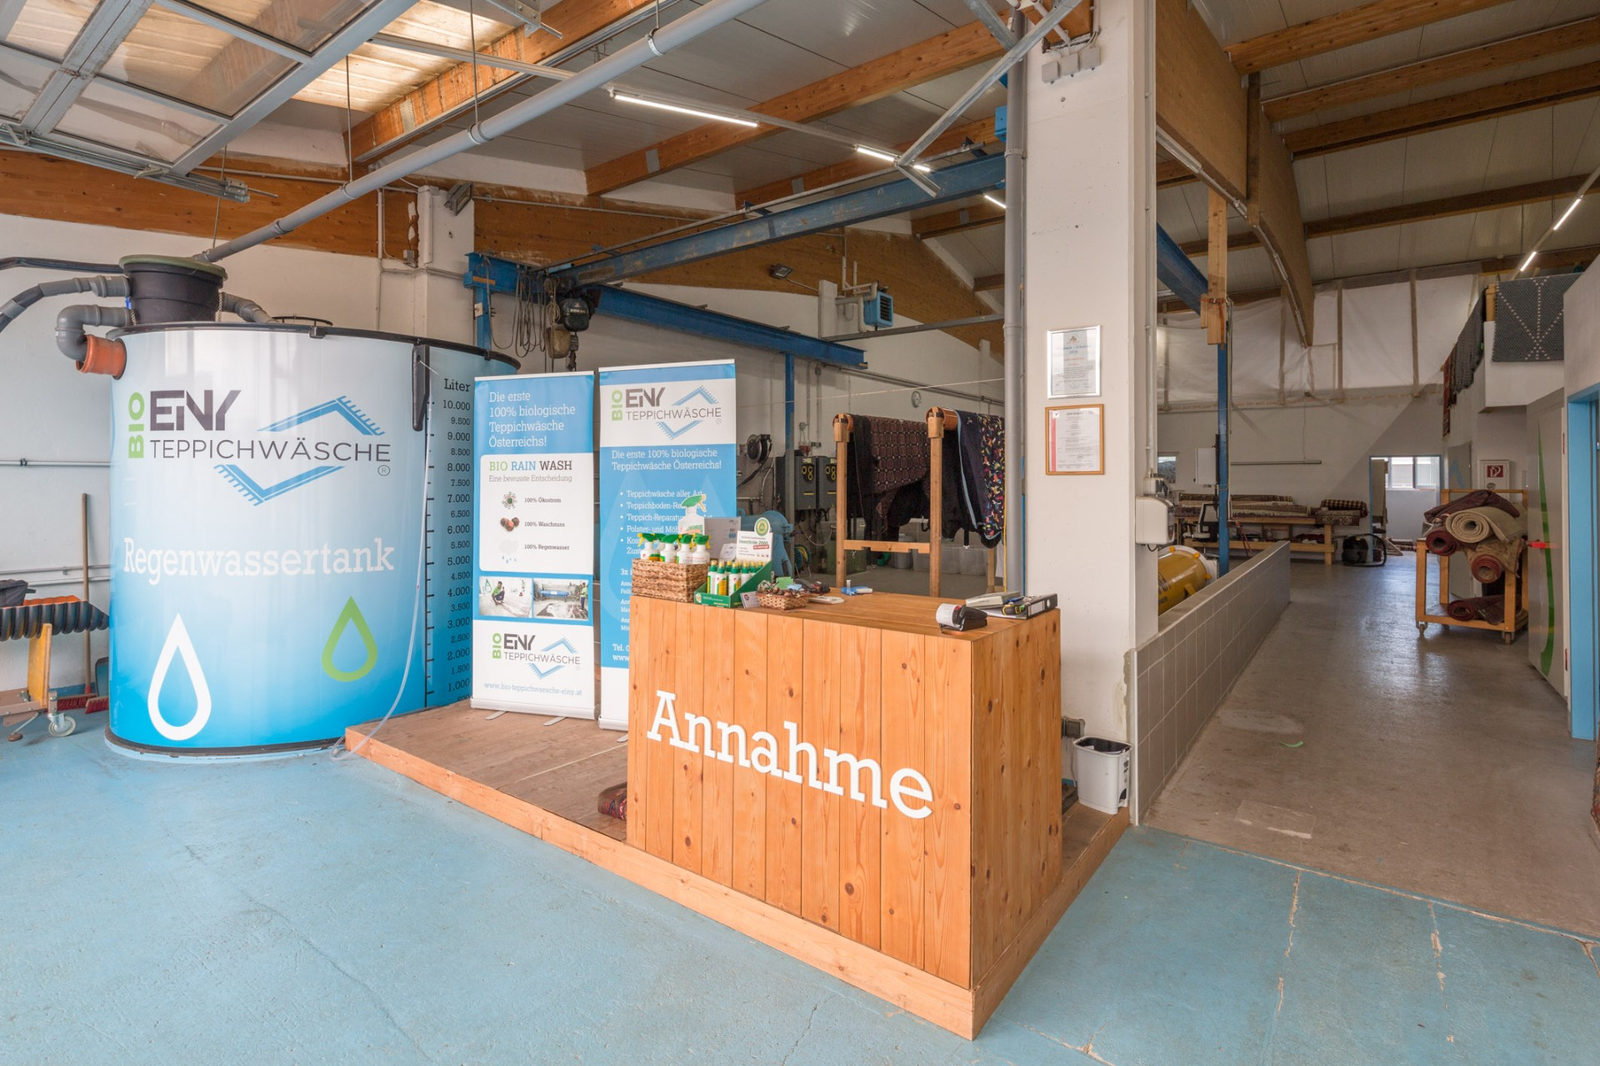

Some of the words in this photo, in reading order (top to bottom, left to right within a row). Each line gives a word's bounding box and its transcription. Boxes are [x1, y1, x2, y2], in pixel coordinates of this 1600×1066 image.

[444, 378, 471, 392] Liter
[489, 392, 505, 402] Die
[507, 392, 531, 402] erste
[443, 400, 470, 411] 10.000
[490, 406, 517, 418] 100%
[519, 404, 576, 418] biologische
[611, 389, 623, 421] BIO
[625, 407, 722, 421] TEPPICHWÄSCHE
[128, 392, 145, 459] BIO
[489, 420, 565, 434] Teppichwäsche
[448, 432, 470, 441] 9.000
[488, 436, 547, 448] Österreichs!
[150, 437, 391, 462] TEPPICHWÄSCHE
[611, 450, 624, 458] Die
[648, 450, 670, 458] 100%
[671, 448, 718, 460] biologische
[448, 463, 470, 472] 8.000
[489, 461, 508, 472] BIO
[511, 461, 536, 471] RAIN
[540, 460, 572, 470] WASH
[611, 461, 672, 472] Teppichwäsche
[673, 460, 722, 470] Österreichs!
[531, 474, 572, 483] Entscheidung
[448, 494, 470, 502] 7.000
[626, 490, 675, 498] Teppichwäsche
[450, 510, 470, 518] 6.500
[448, 525, 470, 534] 6.000
[123, 537, 395, 585] Regenwassertank
[448, 555, 470, 566] 5.000
[450, 571, 470, 580] 4.500
[448, 586, 470, 598] 4.000
[448, 618, 470, 629] 3.000
[492, 632, 502, 659] BIO
[612, 643, 624, 651] Tel.
[448, 647, 470, 661] 2.000
[504, 651, 581, 665] TEPPICHWÄSCHE
[448, 678, 470, 692] 1.000
[646, 690, 933, 819] Annahme
